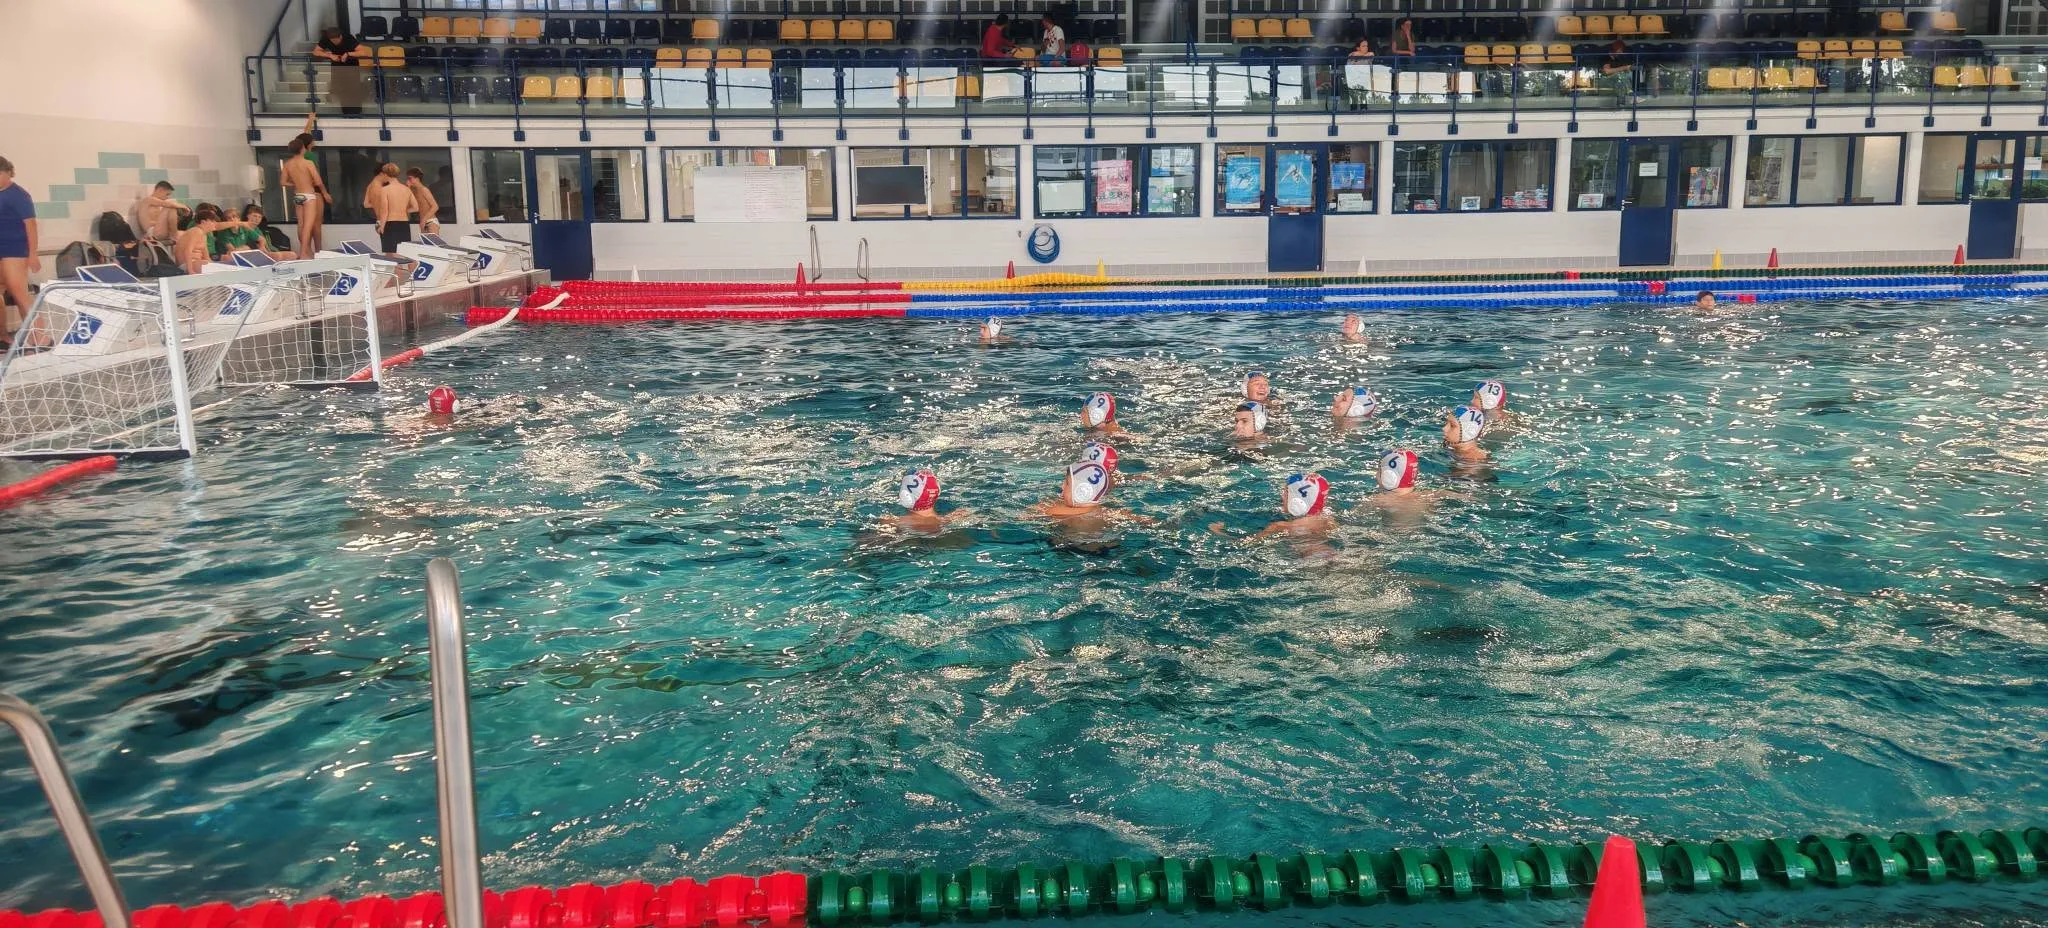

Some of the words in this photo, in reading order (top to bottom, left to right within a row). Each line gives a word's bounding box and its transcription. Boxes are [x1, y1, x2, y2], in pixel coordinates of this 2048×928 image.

[480, 256, 486, 268] 1
[417, 266, 427, 279] 2
[339, 278, 350, 293] 3
[229, 295, 243, 313] 4
[77, 320, 92, 339] 5
[1487, 383, 1501, 396] 13
[1097, 397, 1106, 408] 9
[1469, 410, 1482, 426] 14
[1089, 449, 1100, 461] 3
[1388, 455, 1400, 469] 6
[1087, 467, 1104, 485] 3
[907, 479, 919, 493] 2
[1298, 484, 1311, 498] 4
